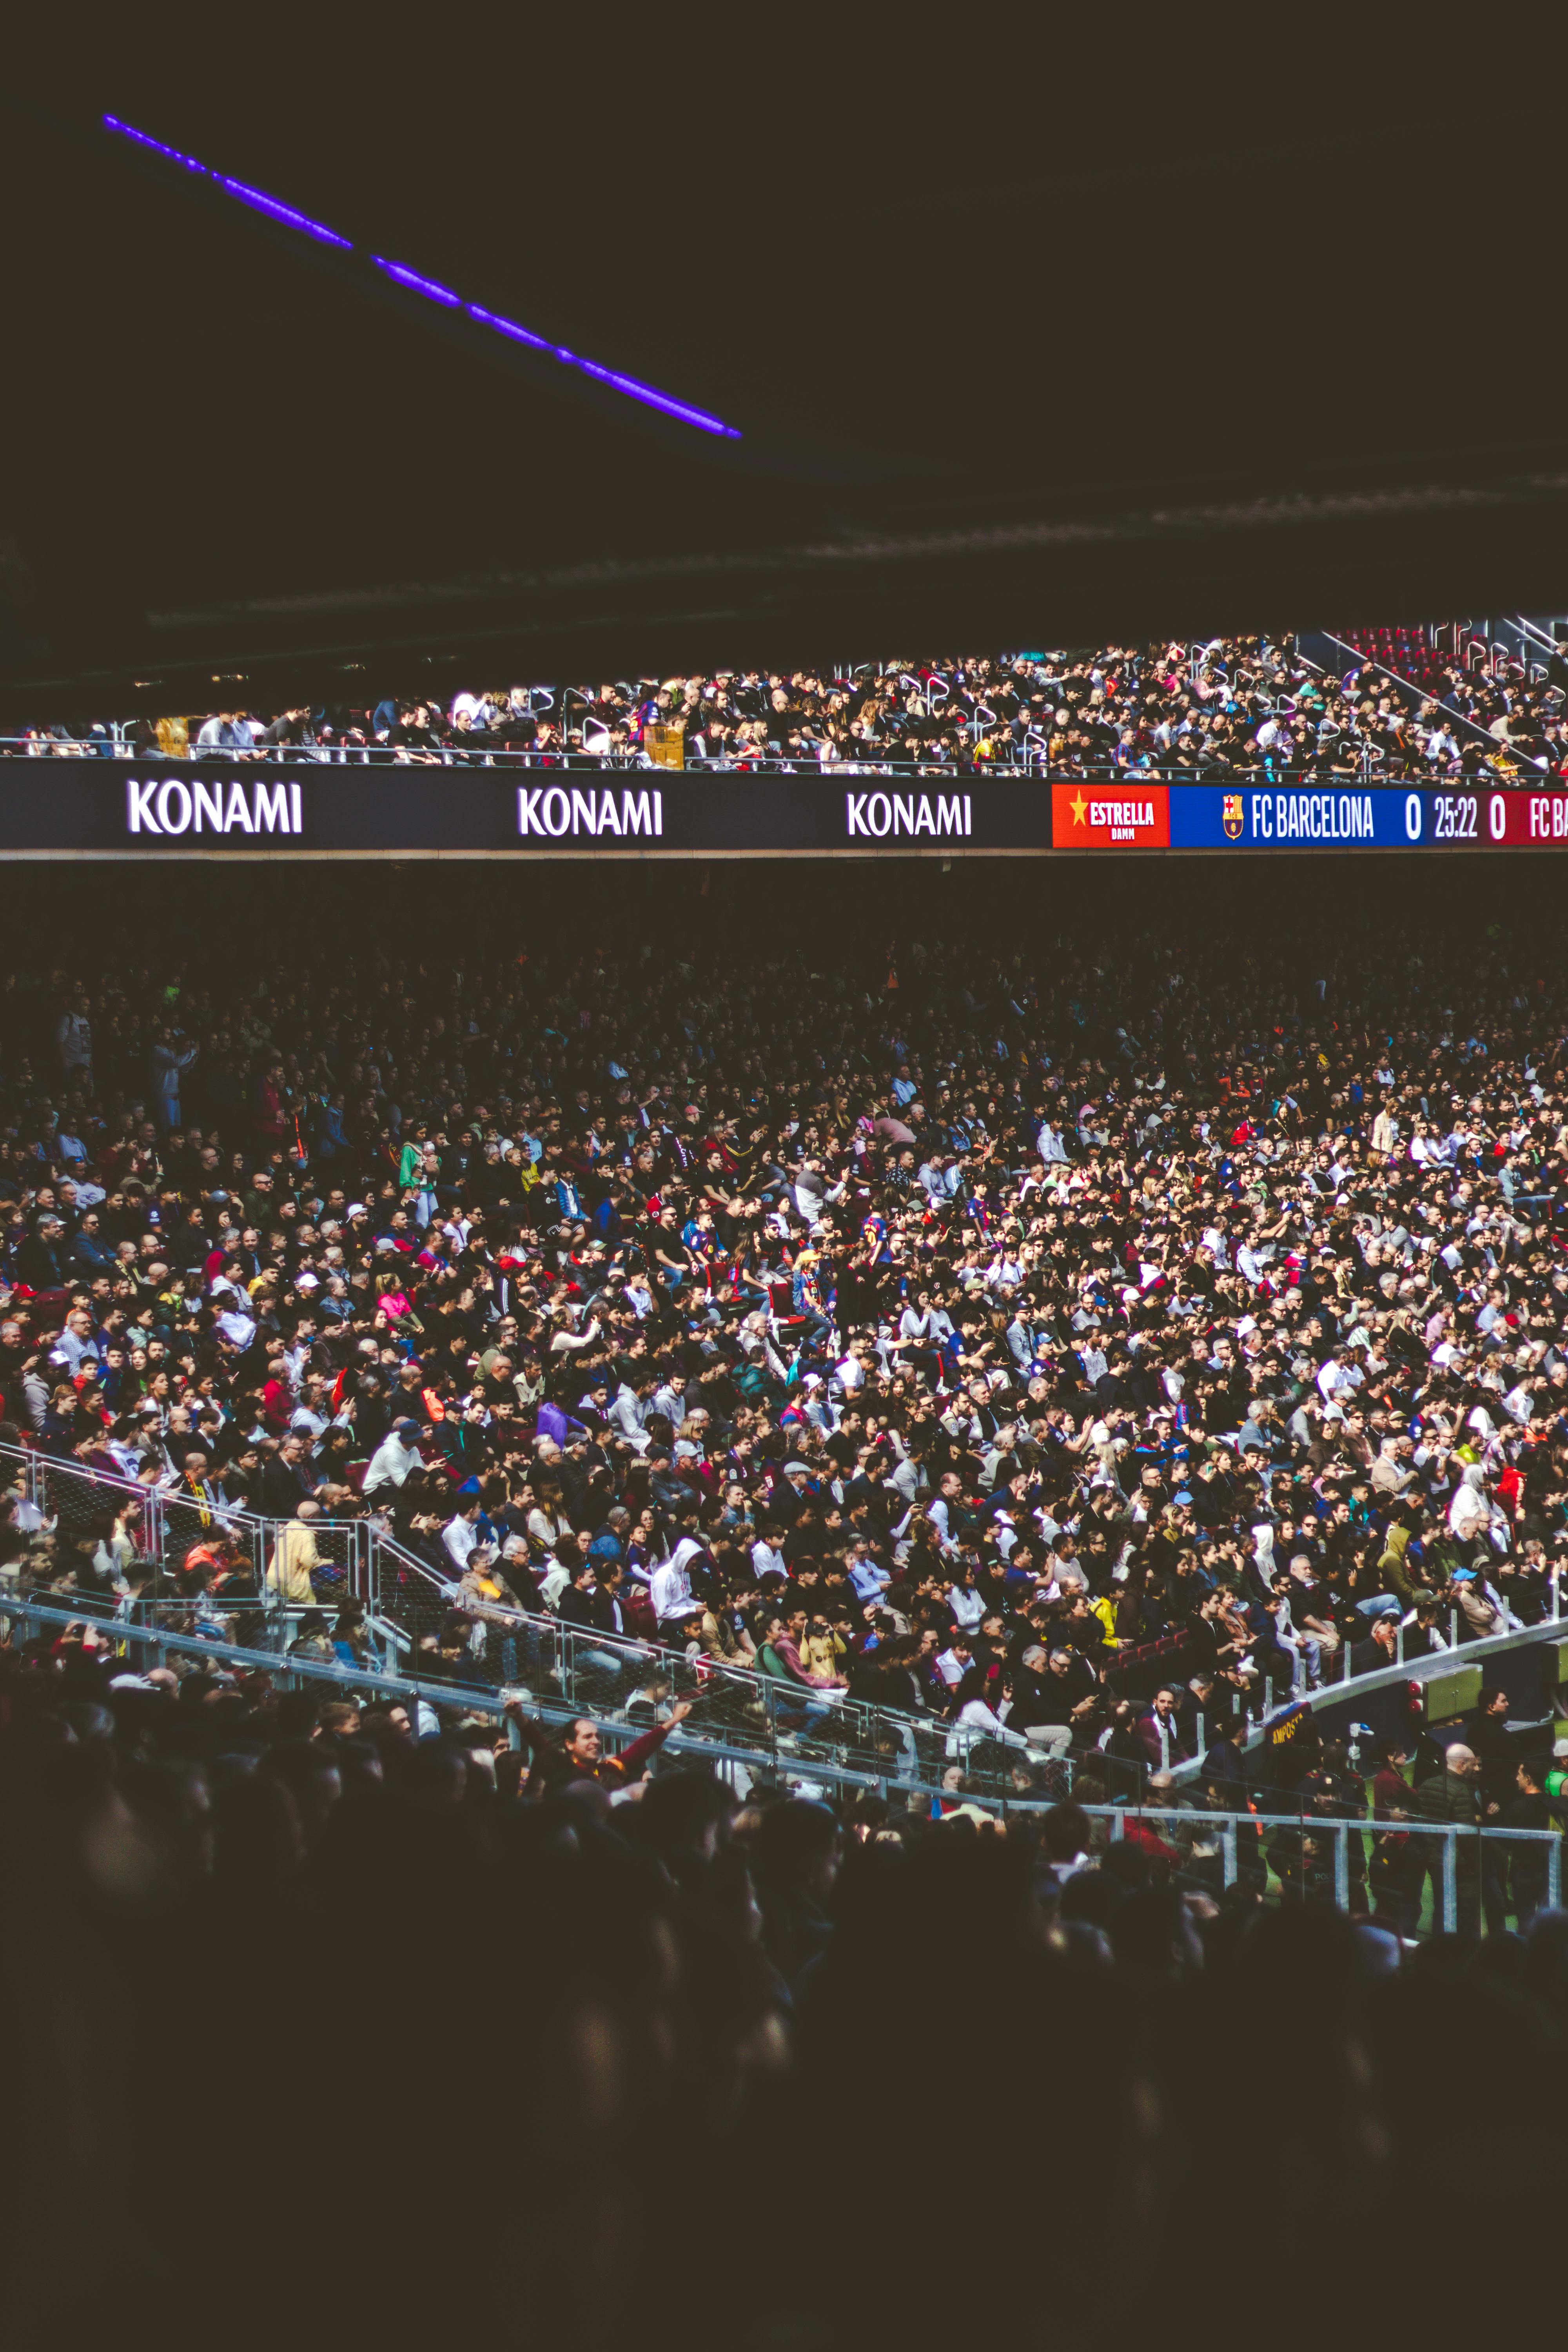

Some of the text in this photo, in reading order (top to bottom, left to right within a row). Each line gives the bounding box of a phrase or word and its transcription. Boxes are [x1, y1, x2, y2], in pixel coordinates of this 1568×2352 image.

[128, 780, 302, 834] KONAMI
[518, 787, 662, 836] KONAMI
[846, 792, 972, 837] KONAMI
[1090, 802, 1154, 825] ESTRELLA
[1252, 794, 1374, 838] FC BARCELONA
[1405, 793, 1422, 840] 0
[1434, 797, 1478, 838] 25:22
[1490, 795, 1506, 840] 0
[1530, 797, 1550, 837] FC
[1111, 828, 1135, 840] DAMM
